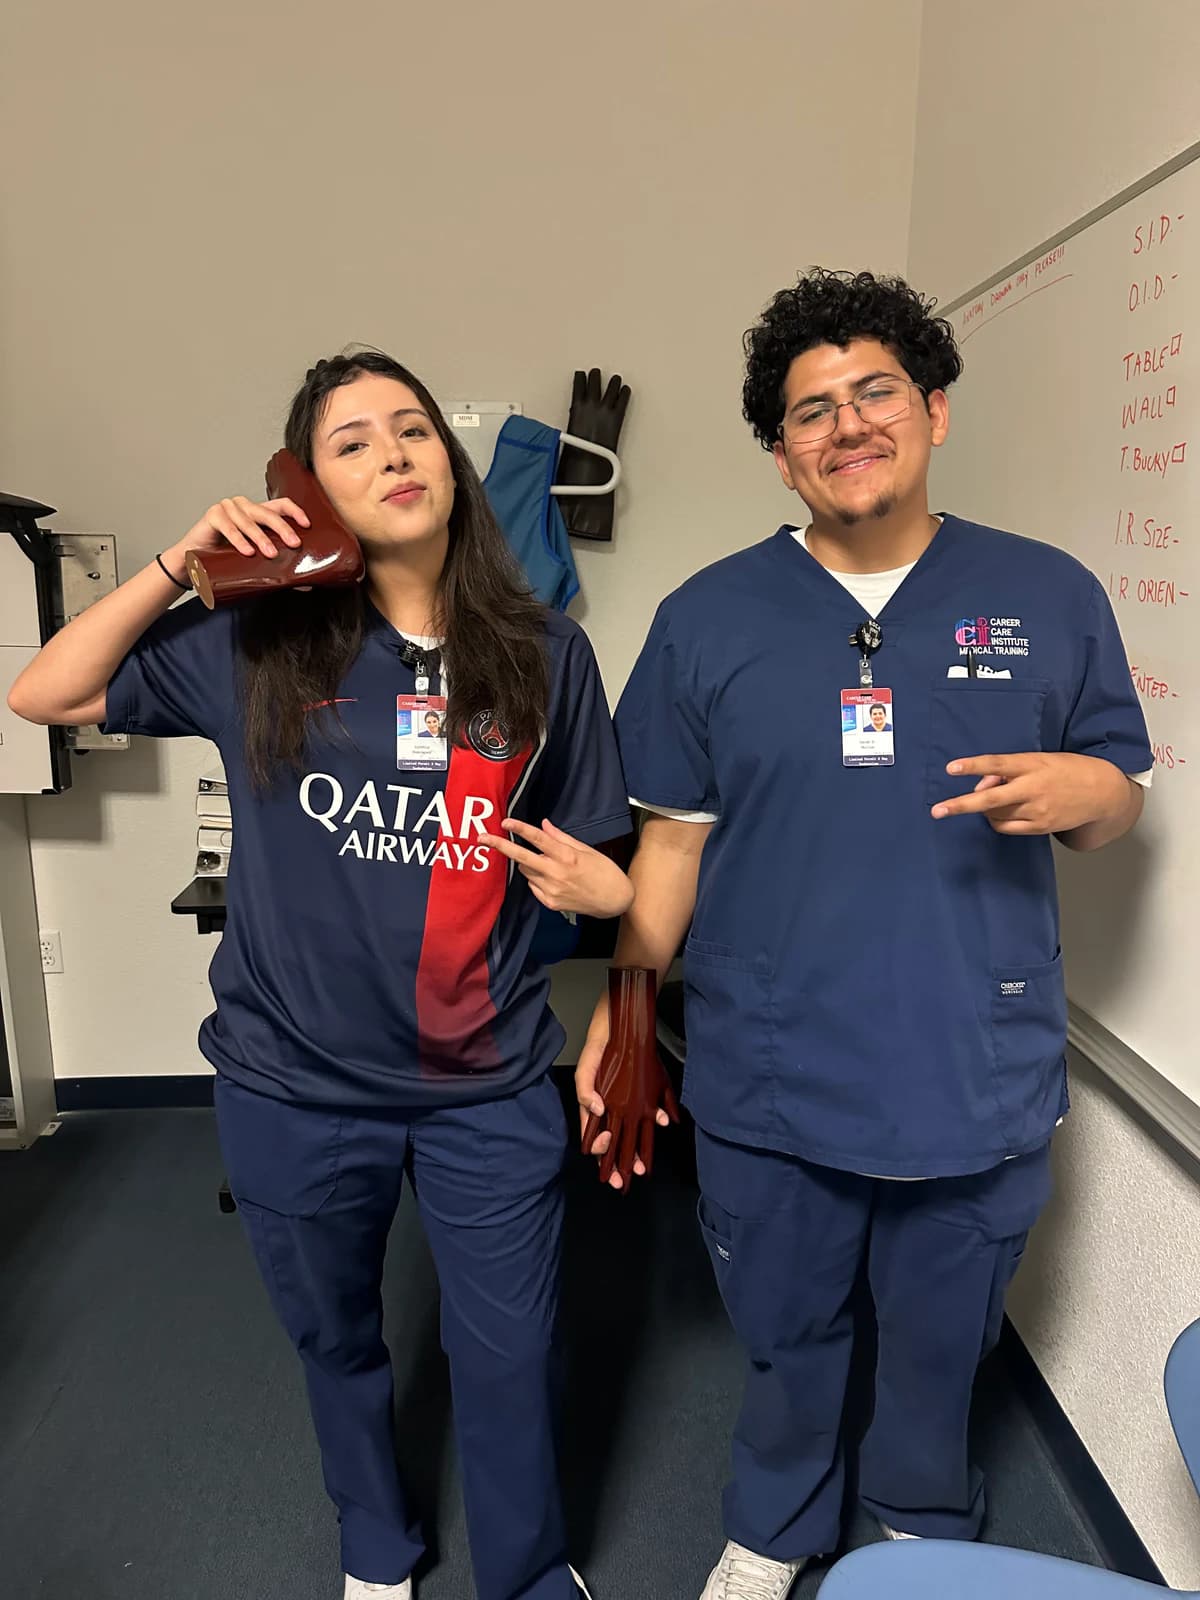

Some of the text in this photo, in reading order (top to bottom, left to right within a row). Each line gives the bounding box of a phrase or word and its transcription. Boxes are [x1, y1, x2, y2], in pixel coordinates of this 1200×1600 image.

[1123, 346, 1169, 381] TABLE
[1122, 395, 1163, 429] WALL
[990, 617, 1021, 627] CAREER
[990, 627, 1013, 636] CARE
[991, 637, 1029, 647] INSTITUTE
[994, 646, 1029, 656] TRAINING
[299, 772, 494, 840] QATAR
[338, 829, 490, 873] AIRWAYS
